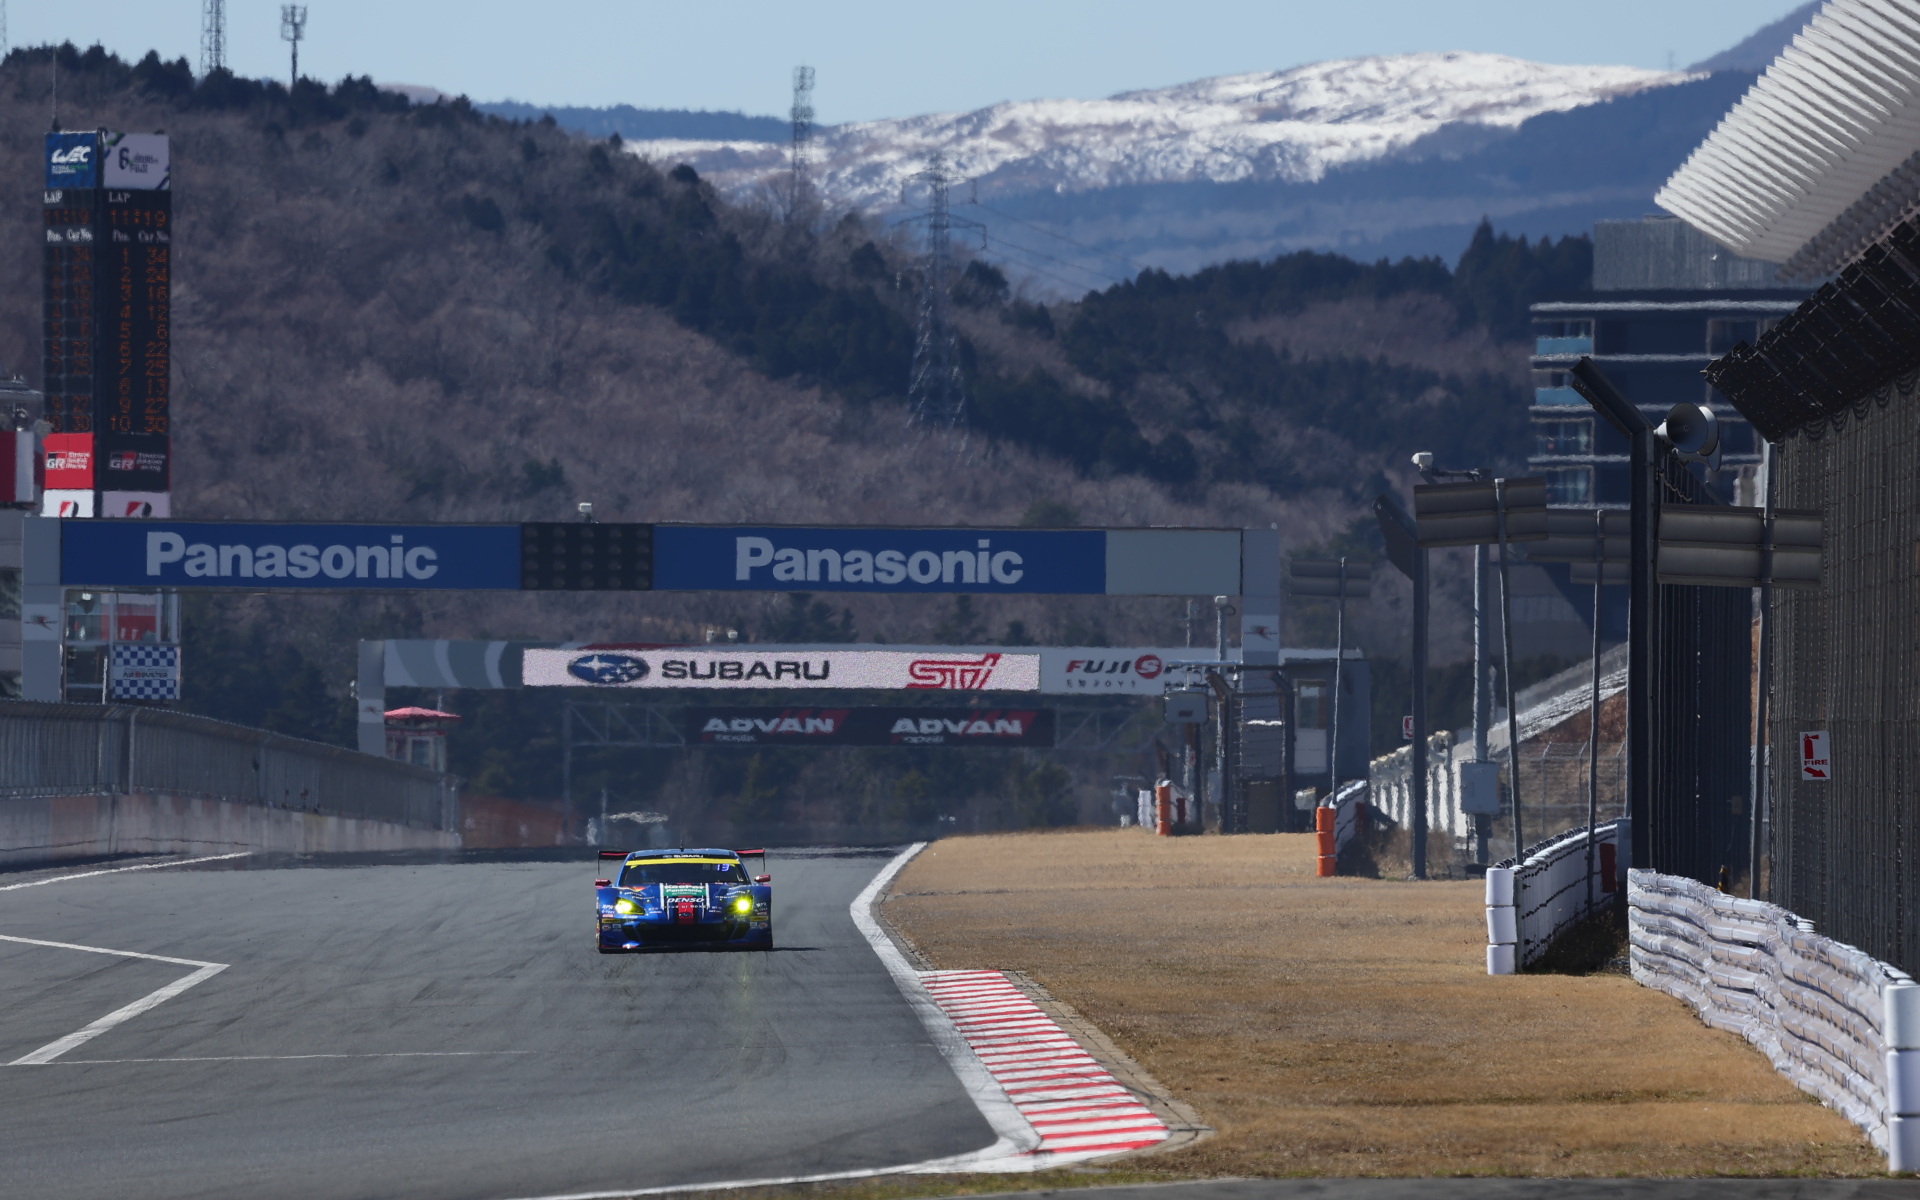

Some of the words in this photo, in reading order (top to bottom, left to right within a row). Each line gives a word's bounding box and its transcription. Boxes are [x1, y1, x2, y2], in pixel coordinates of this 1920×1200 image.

[51, 145, 91, 164] WEC
[118, 146, 130, 170] 6
[43, 190, 63, 203] LAP
[107, 191, 131, 203] LAP
[46, 458, 66, 470] GR
[110, 458, 134, 470] GR
[146, 531, 438, 580] Panasonic
[735, 536, 1024, 584] Panasonic
[661, 659, 829, 681] SUBARU
[904, 653, 1002, 689] STI
[1065, 659, 1131, 674] FUJI
[702, 716, 834, 734] ADVAN
[890, 717, 1023, 735] ADVAN
